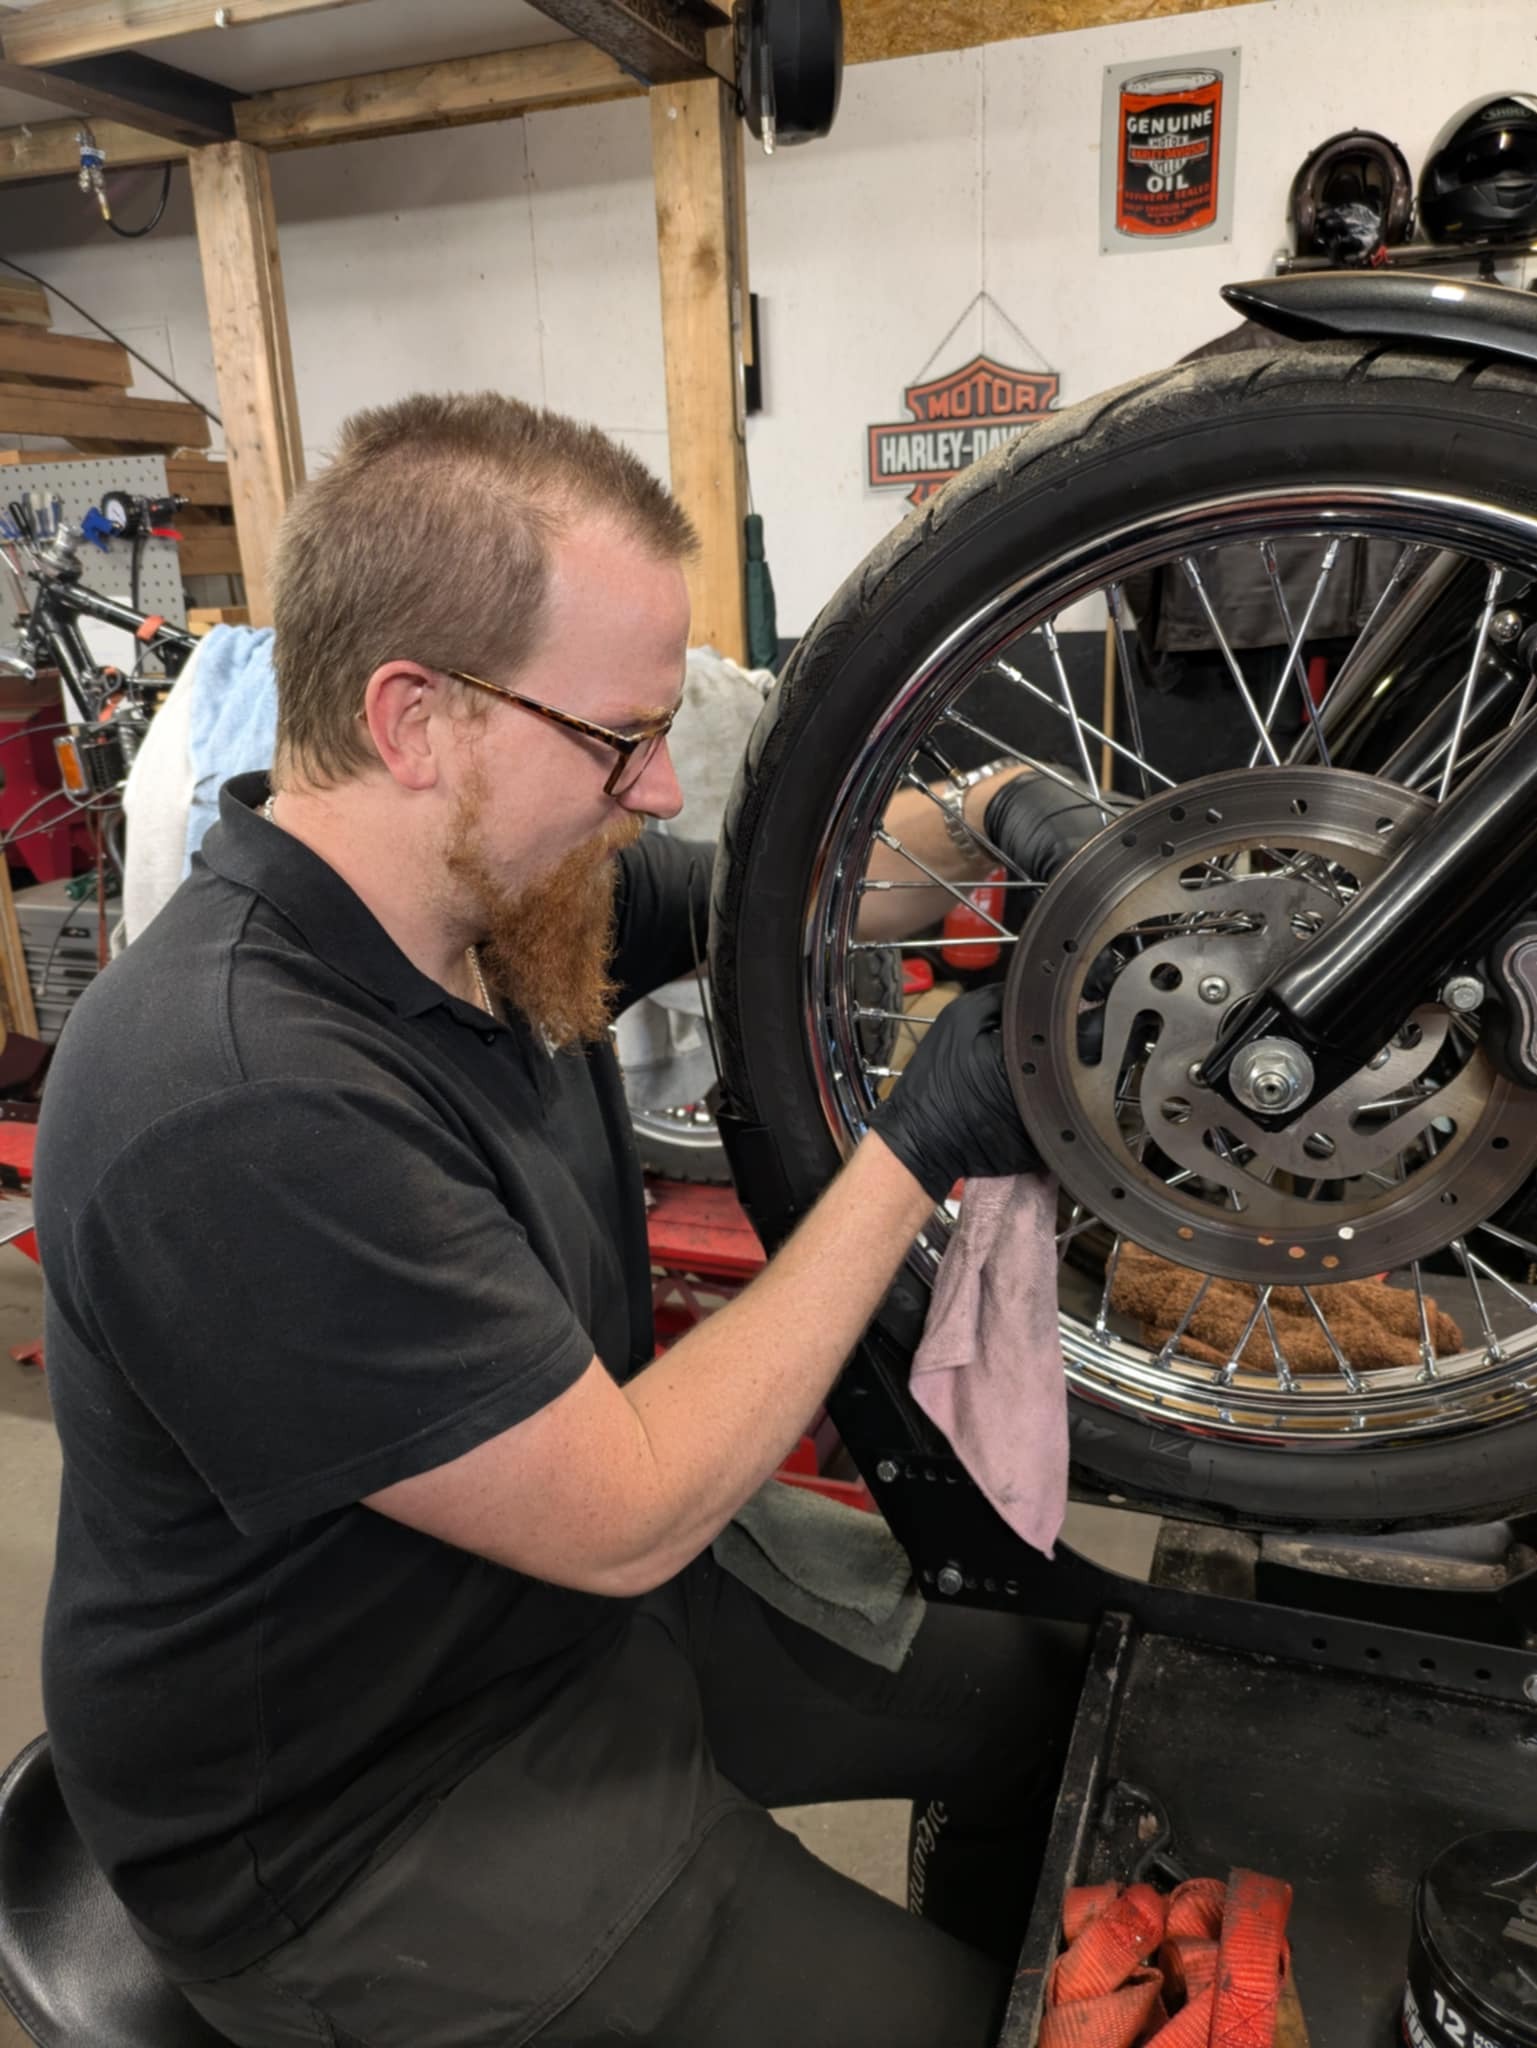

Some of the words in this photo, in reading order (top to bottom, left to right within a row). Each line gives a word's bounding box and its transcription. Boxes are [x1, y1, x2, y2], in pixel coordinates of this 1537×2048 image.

[1127, 109, 1212, 133] GENUINE
[1146, 176, 1190, 193] OIL
[927, 372, 1037, 420] MOTOR
[881, 426, 1026, 473] HARLEY-DA
[1433, 1989, 1466, 2048] 12
